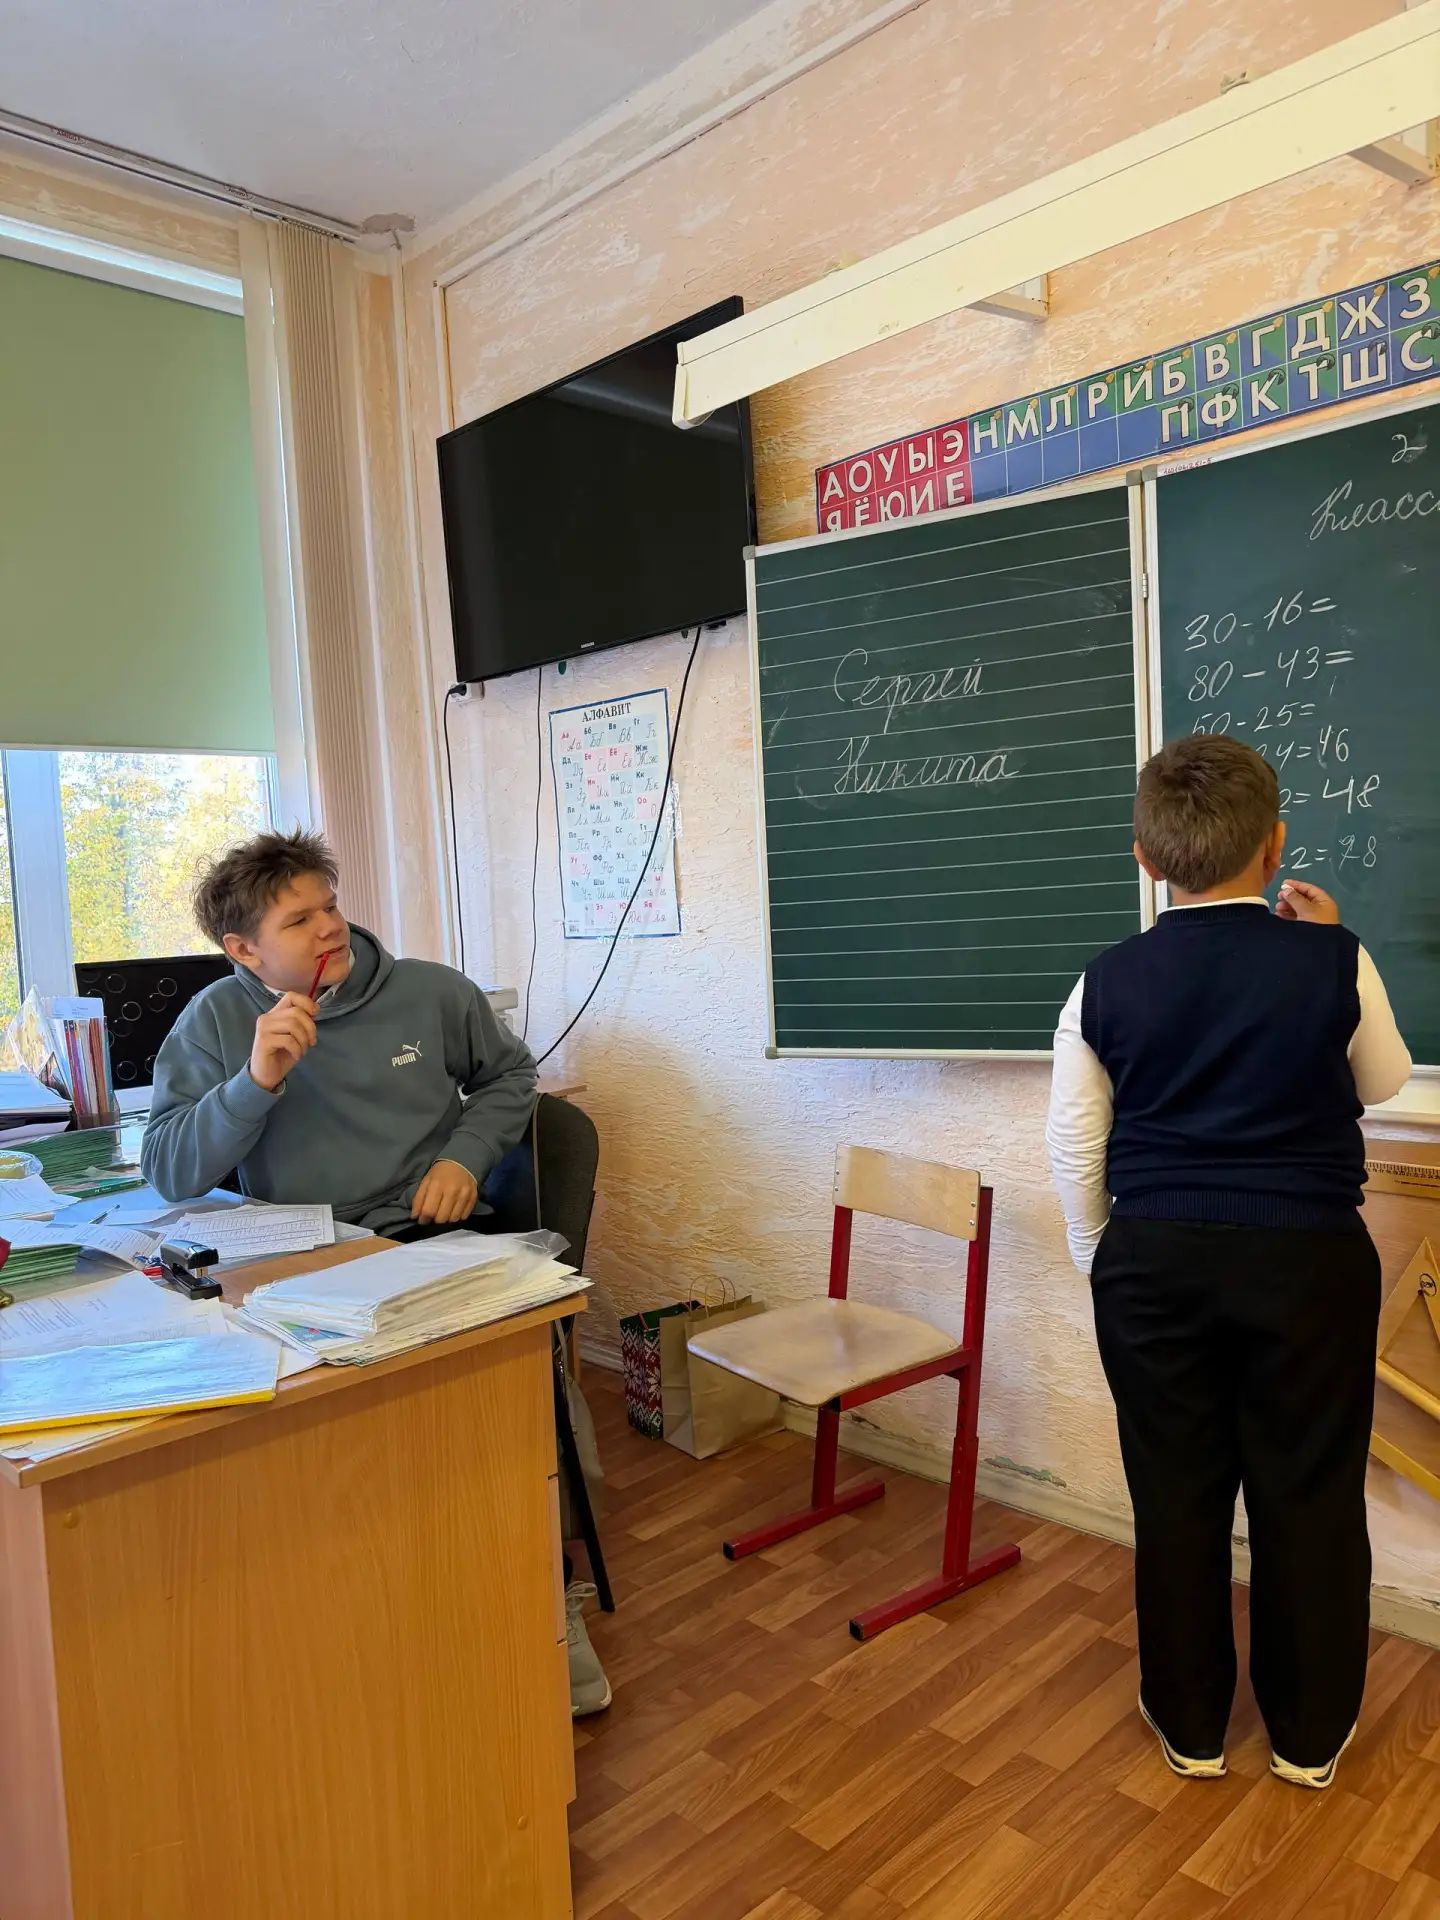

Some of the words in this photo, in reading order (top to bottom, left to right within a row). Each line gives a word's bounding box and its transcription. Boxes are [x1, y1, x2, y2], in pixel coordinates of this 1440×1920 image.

[822, 471, 845, 504] А
[849, 460, 872, 493] О
[877, 448, 899, 483] У
[908, 437, 934, 474] Ы
[942, 429, 964, 463] Э
[973, 415, 999, 454] Н
[1006, 403, 1039, 445] М
[1046, 393, 1072, 433] Л
[1088, 381, 1109, 419] Р
[1123, 365, 1153, 408] Й
[1163, 356, 1186, 396] Б
[1205, 343, 1230, 382] В
[1252, 324, 1276, 368] Г
[1290, 308, 1331, 360] Д
[1339, 295, 1387, 341] Ж
[1400, 277, 1432, 319] З
[826, 510, 842, 531] Я
[855, 496, 870, 527] Ё
[879, 491, 905, 523] Ю
[910, 479, 935, 517] И
[945, 471, 965, 507] Е
[1161, 402, 1190, 444] П
[1201, 391, 1238, 428] Ф
[1251, 372, 1281, 418] К
[1298, 359, 1329, 401] Т
[1342, 343, 1387, 392] Ш
[1401, 329, 1434, 372] С
[1309, 479, 1440, 541] Класс
[582, 702, 632, 722] АЛФАВИТ
[834, 648, 984, 734] Сергей
[834, 736, 1019, 794] Никита
[392, 1052, 417, 1067] PUMA
